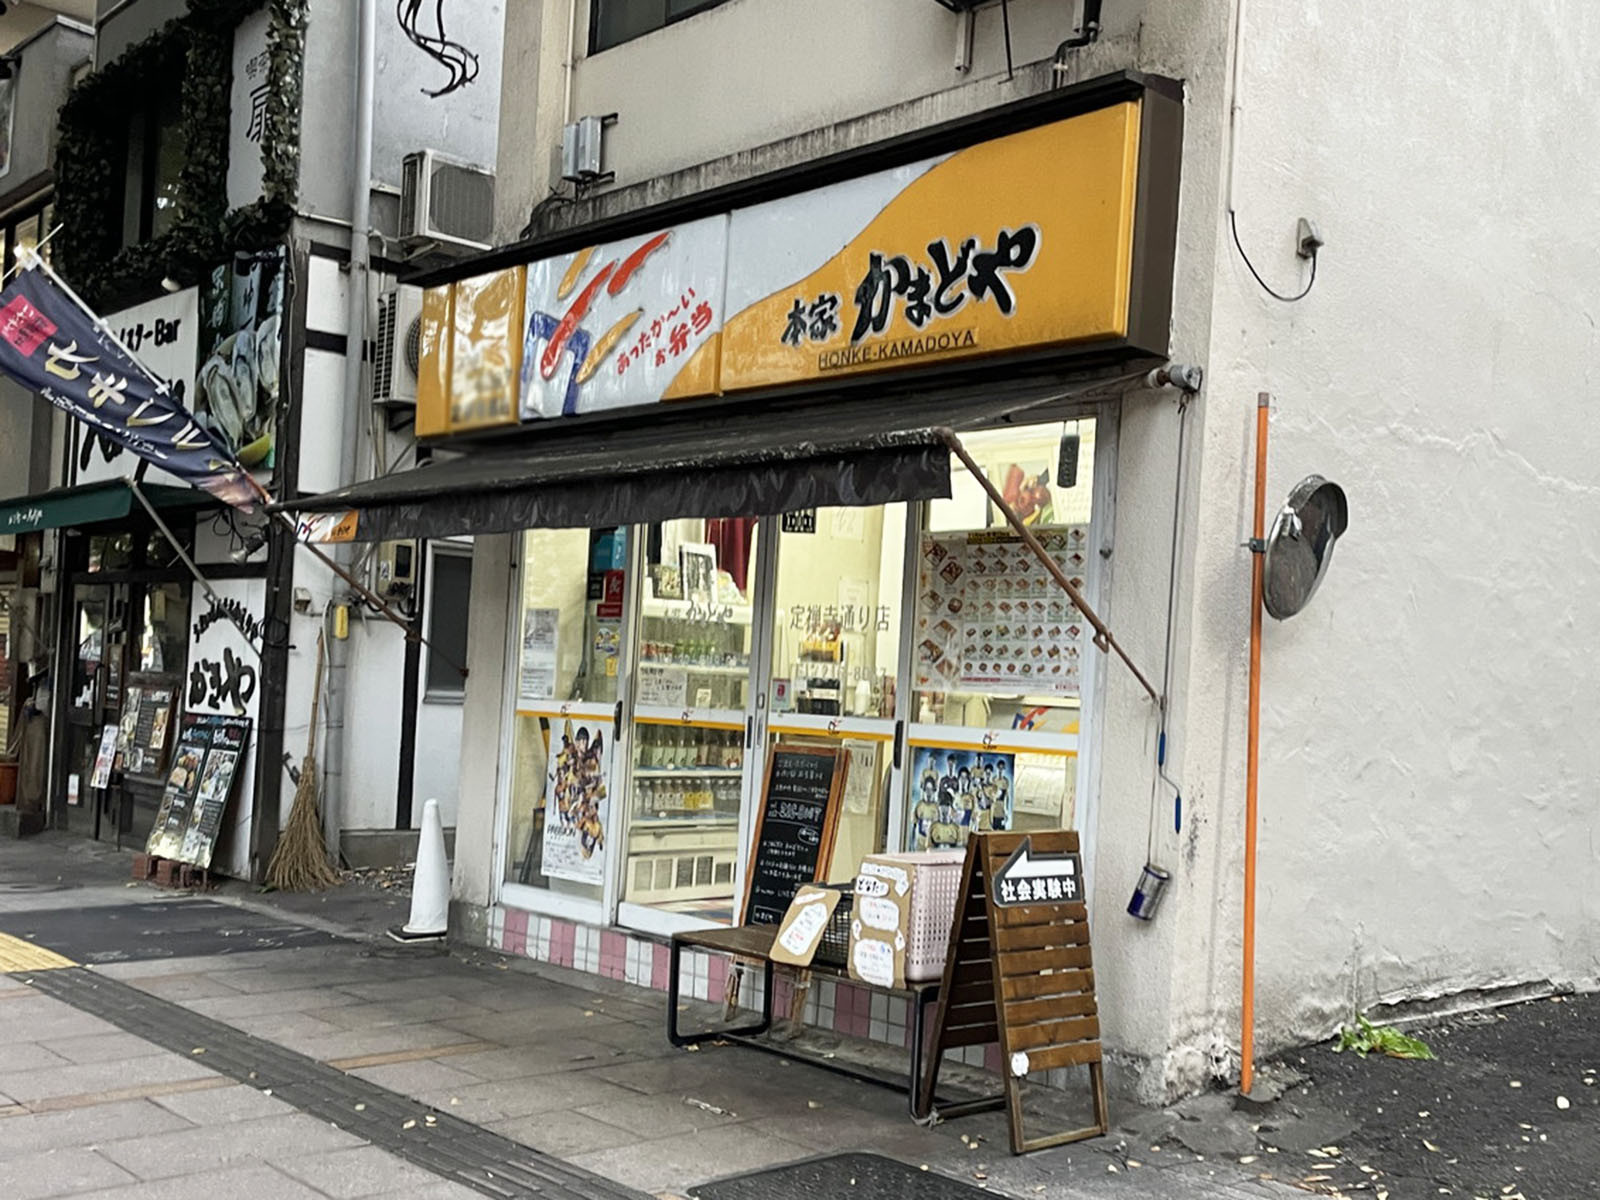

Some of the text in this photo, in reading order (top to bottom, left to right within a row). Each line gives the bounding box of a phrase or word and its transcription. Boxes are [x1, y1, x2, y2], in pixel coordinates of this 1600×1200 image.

[781, 226, 1037, 346] 本家 かまどや
[655, 300, 713, 368] お弁当
[818, 329, 976, 370] HONKE-KAMADOYA
[1001, 877, 1076, 903] 社会実験中
